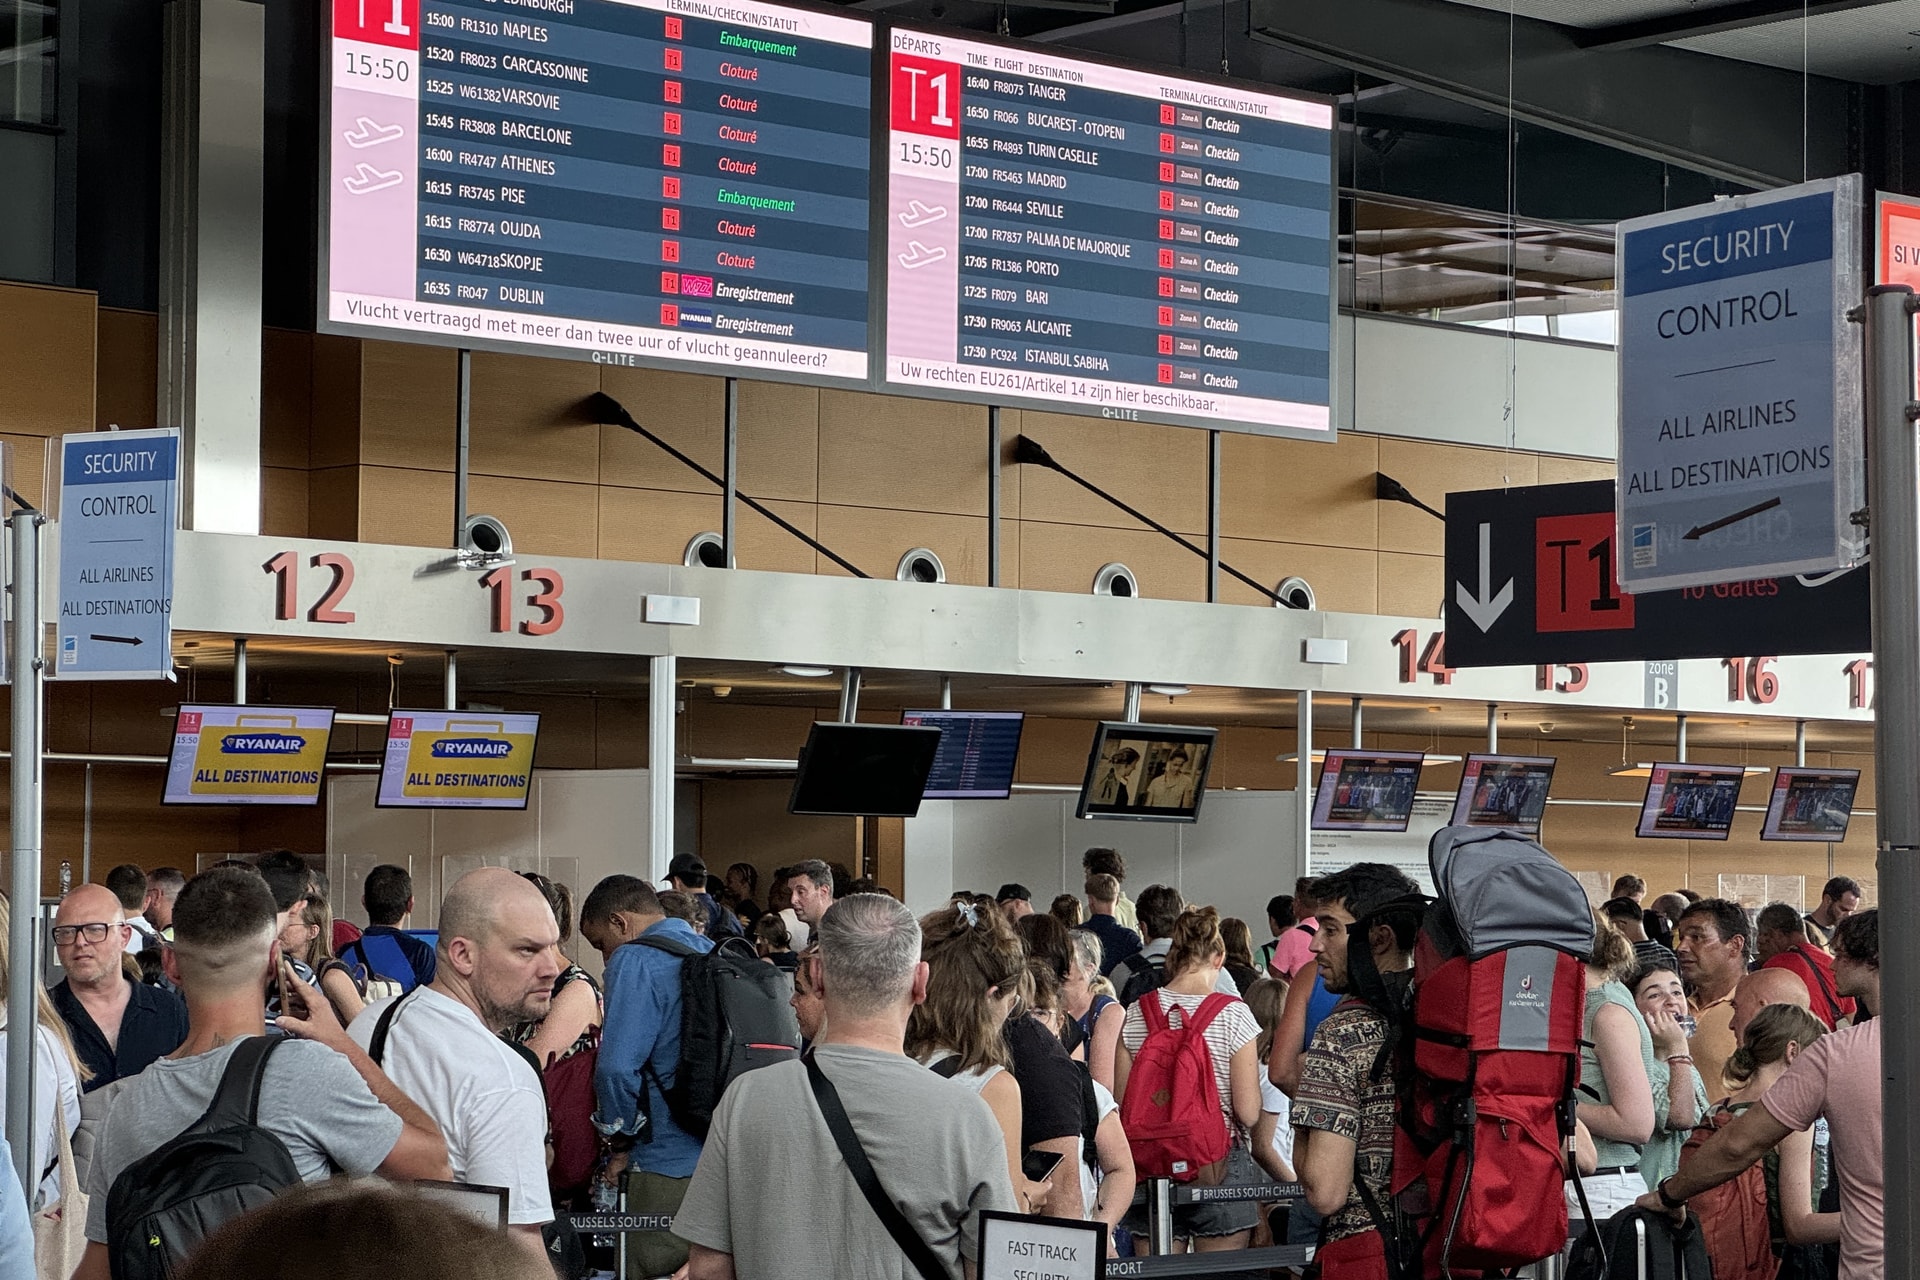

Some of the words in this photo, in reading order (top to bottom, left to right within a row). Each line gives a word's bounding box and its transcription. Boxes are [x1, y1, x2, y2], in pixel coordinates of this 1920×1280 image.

[666, 0, 798, 32] TERMINAL/CHECKIN/STATUT
[346, 52, 409, 82] 15:50
[427, 13, 454, 28] 15:00
[460, 18, 498, 36] FR1310
[504, 22, 548, 42] NAPLES
[720, 62, 758, 81] Cloturé
[720, 31, 797, 56] Embarquement
[894, 34, 941, 56] DÉPARTS
[427, 46, 454, 62] 15:20
[460, 51, 496, 69] FR8023
[502, 56, 588, 82] CARCASSONNE
[720, 94, 758, 112] Cloturé
[900, 66, 952, 128] T1
[966, 52, 988, 66] TIME
[994, 58, 1024, 72] FLIGHT
[1028, 64, 1084, 82] DESTINATION
[1160, 87, 1268, 115] TERMINAL/CHECKIN/STATUT
[426, 80, 454, 94] 15:25
[460, 85, 500, 102] W61382
[501, 88, 560, 110] VARSOVIE
[719, 126, 757, 144] Cloturé
[966, 76, 989, 90] 16:40
[994, 80, 1024, 96] FR8073
[1028, 82, 1066, 102] TANGER
[1206, 116, 1240, 134] Checkin
[426, 114, 454, 128] 15:45
[460, 118, 496, 135] FR3808
[502, 121, 572, 146] BARCELONE
[718, 158, 756, 176] Cloturé
[900, 142, 952, 168] 15:50
[966, 106, 988, 120] 16:50
[994, 110, 1018, 124] FR066
[1028, 112, 1078, 132] BUCAREST
[1084, 122, 1125, 140] OTOPENI
[1206, 144, 1240, 162] Checkin
[426, 148, 452, 162] 16:00
[459, 152, 496, 168] FR4747
[501, 154, 556, 176] ATHENES
[718, 189, 796, 212] Embarquement
[966, 136, 988, 150] 16:55
[993, 140, 1023, 156] FR4893
[1027, 142, 1056, 160] TURIN
[1058, 147, 1098, 166] CASELLE
[1205, 174, 1239, 190] Checkin
[425, 180, 452, 196] 16:15
[459, 185, 495, 202] FR3745
[501, 188, 526, 204] PISE
[718, 220, 756, 238] Cloturé
[966, 166, 988, 180] 17:00
[992, 169, 1022, 184] FR5463
[1027, 171, 1066, 190] MADRID
[1205, 202, 1239, 218] Checkin
[425, 214, 452, 230] 16:15
[458, 218, 495, 236] FR8774
[500, 220, 542, 240] OUJDA
[717, 252, 755, 270] Cloturé
[965, 196, 988, 209] 17:00
[992, 199, 1022, 214] FR6444
[1026, 201, 1064, 218] SEVILLE
[1204, 230, 1239, 247] Checkin
[965, 226, 988, 240] 17:00
[992, 230, 1022, 244] FR7837
[1026, 231, 1060, 248] PALMA
[1062, 236, 1076, 250] DE
[1077, 238, 1130, 258] MAJORQUE
[1204, 260, 1238, 276] Checkin
[1662, 220, 1794, 274] SECURITY
[1894, 244, 1906, 264] SI
[424, 248, 451, 263] 16:30
[458, 252, 500, 269] W64718
[500, 253, 543, 273] SKOPJE
[716, 283, 794, 306] Enregistrement
[964, 256, 987, 270] 17:05
[992, 259, 1022, 274] FR1386
[1026, 260, 1059, 277] PORTO
[1204, 288, 1238, 304] Checkin
[424, 282, 450, 296] 16:35
[458, 284, 488, 300] FR047
[500, 286, 544, 305] DUBLIN
[680, 313, 712, 324] RYANAIR
[716, 315, 794, 337] Enregistrement
[964, 286, 986, 298] 17:25
[992, 288, 1016, 302] FR079
[1026, 290, 1048, 305] BARI
[1204, 316, 1238, 333] Checkin
[1657, 288, 1797, 340] CONTROL
[348, 300, 398, 320] Vlucht
[404, 308, 481, 332] vertraagd
[487, 318, 517, 334] met
[522, 322, 560, 338] meer
[566, 325, 592, 342] dan
[598, 328, 633, 346] twee
[638, 335, 663, 350] uur
[667, 336, 682, 352] of
[686, 338, 730, 358] vlucht
[734, 347, 828, 368] geannuleerd?
[964, 316, 986, 328] 17:30
[991, 318, 1022, 333] FR9063
[1025, 320, 1072, 338] ALICANTE
[1204, 344, 1238, 361] Checkin
[592, 351, 635, 366] Q-LITE
[964, 346, 986, 359] 17:30
[990, 348, 1017, 362] PC924
[1074, 355, 1109, 371] SABIHA
[1204, 373, 1238, 390] Checkin
[901, 362, 921, 378] Uw
[926, 367, 976, 384] rechten
[980, 372, 1066, 394] EU261/Artikel
[1072, 382, 1086, 396] 14
[1090, 384, 1111, 402] zijn
[1116, 386, 1138, 402] hier
[1144, 390, 1218, 412] beschikbaar.
[1102, 407, 1138, 421] Q-LITE
[1658, 416, 1694, 442] ALL
[1702, 399, 1796, 436] AIRLINES
[84, 451, 157, 474] SECURITY
[1628, 470, 1664, 495] ALL
[1672, 445, 1830, 490] DESTINATIONS
[80, 494, 156, 517] CONTROL
[80, 568, 100, 584] ALL
[103, 566, 154, 582] AIRLINES
[262, 551, 356, 624] 12
[1546, 536, 1620, 613] T1
[1712, 578, 1780, 598] Gates
[62, 600, 82, 617] ALL
[86, 598, 171, 616] DESTINATIONS
[478, 566, 564, 636] 13
[1391, 628, 1456, 685] 14
[1649, 661, 1674, 676] zone
[1720, 656, 1778, 703] 16
[1655, 678, 1669, 709] B
[235, 738, 300, 750] RYANAIR
[445, 742, 508, 754] RYANAIR
[195, 770, 220, 782] ALL
[224, 770, 318, 784] DESTINATIONS
[408, 773, 430, 786] ALL
[435, 774, 526, 788] DESTINATIONS
[1203, 1188, 1242, 1200] BRUSSELS
[1243, 1186, 1272, 1198] SOUTH
[618, 1216, 658, 1228] SOUTH
[1008, 1240, 1036, 1258] FAST
[1038, 1244, 1078, 1262] TRACK
